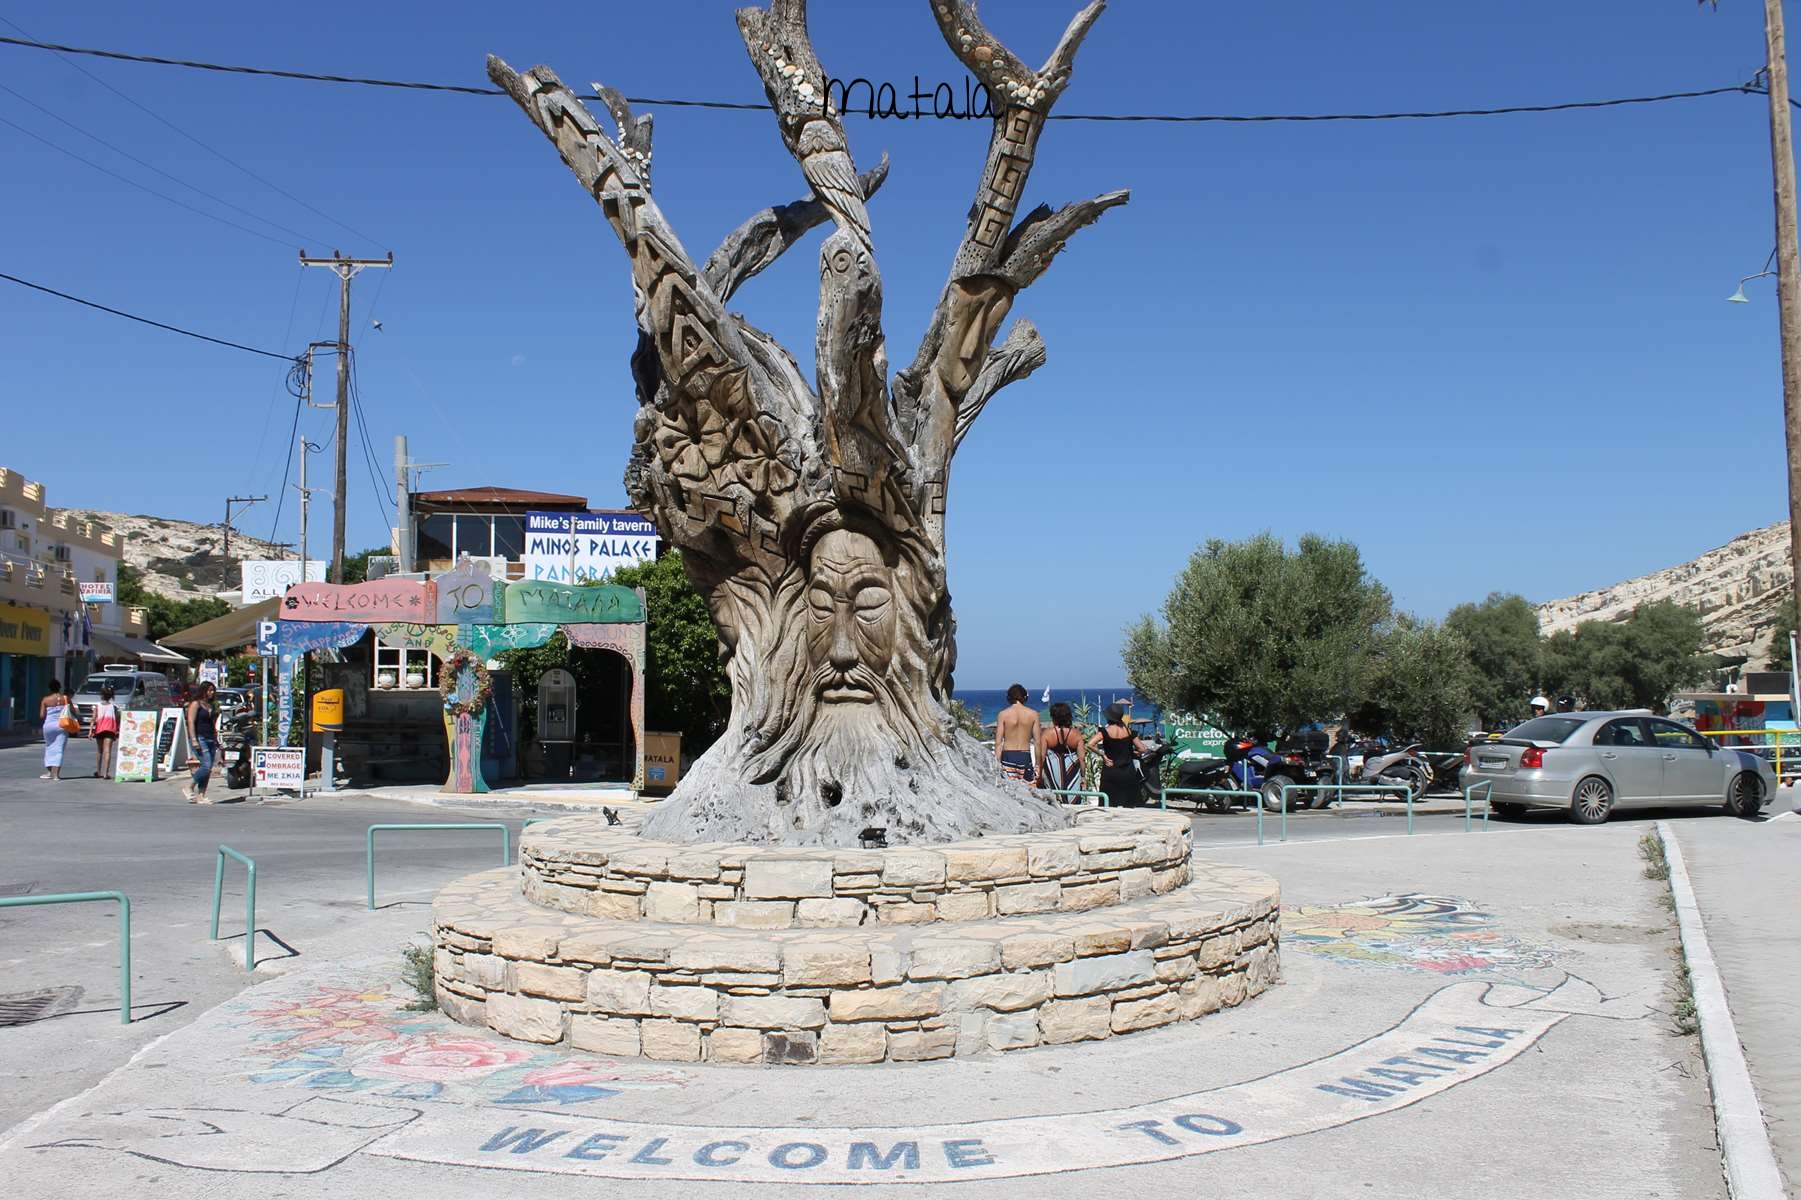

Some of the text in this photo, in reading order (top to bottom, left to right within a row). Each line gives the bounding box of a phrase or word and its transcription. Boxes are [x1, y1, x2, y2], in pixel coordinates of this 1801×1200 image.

[530, 515, 569, 529] Mike's
[613, 518, 652, 531] tavern
[531, 537, 651, 557] MINOS PALACE
[301, 592, 404, 611] WELCOME
[479, 1025, 1526, 1170] WELCOME TO MATALA
